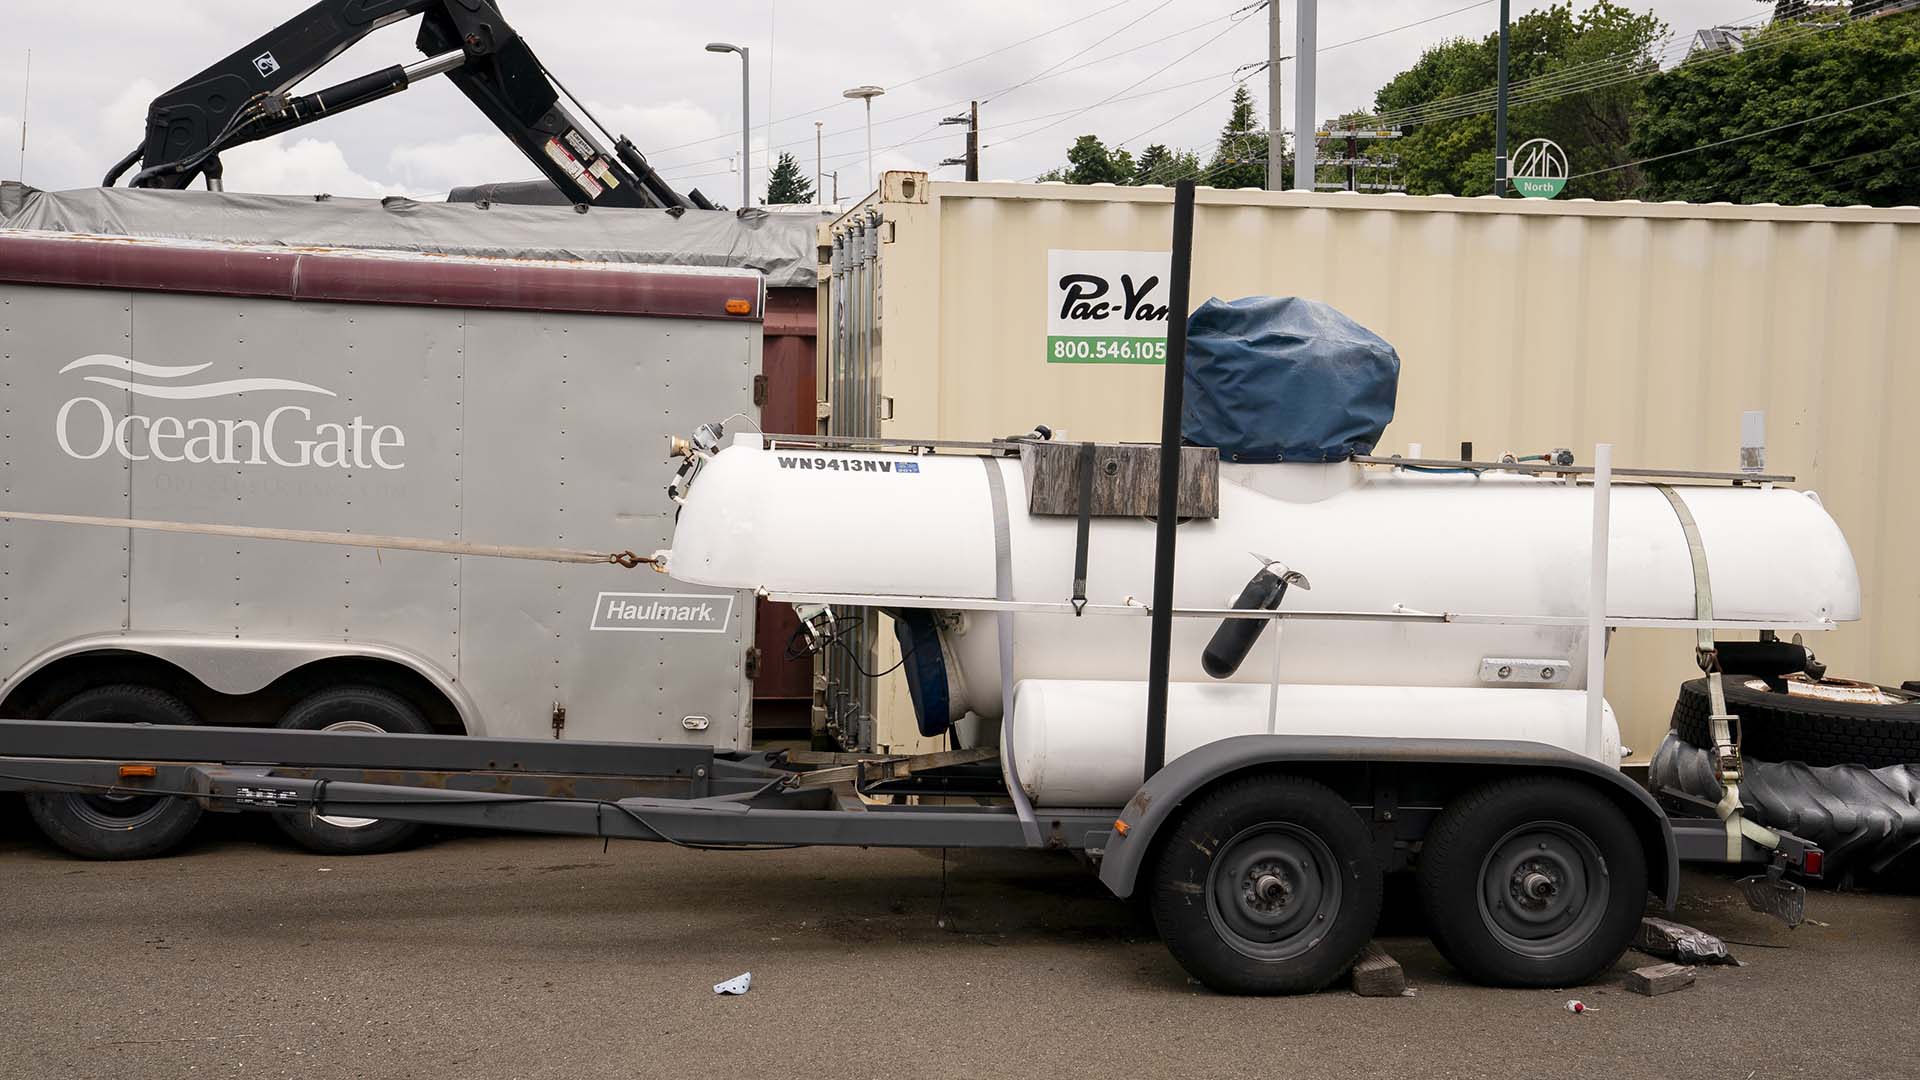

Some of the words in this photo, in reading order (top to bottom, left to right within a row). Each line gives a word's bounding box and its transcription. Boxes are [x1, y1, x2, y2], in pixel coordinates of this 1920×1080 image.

[1524, 182, 1554, 192] North
[1054, 341, 1167, 359] 800.546.105
[56, 397, 405, 469] OceanGate
[777, 457, 891, 473] WN9413NV
